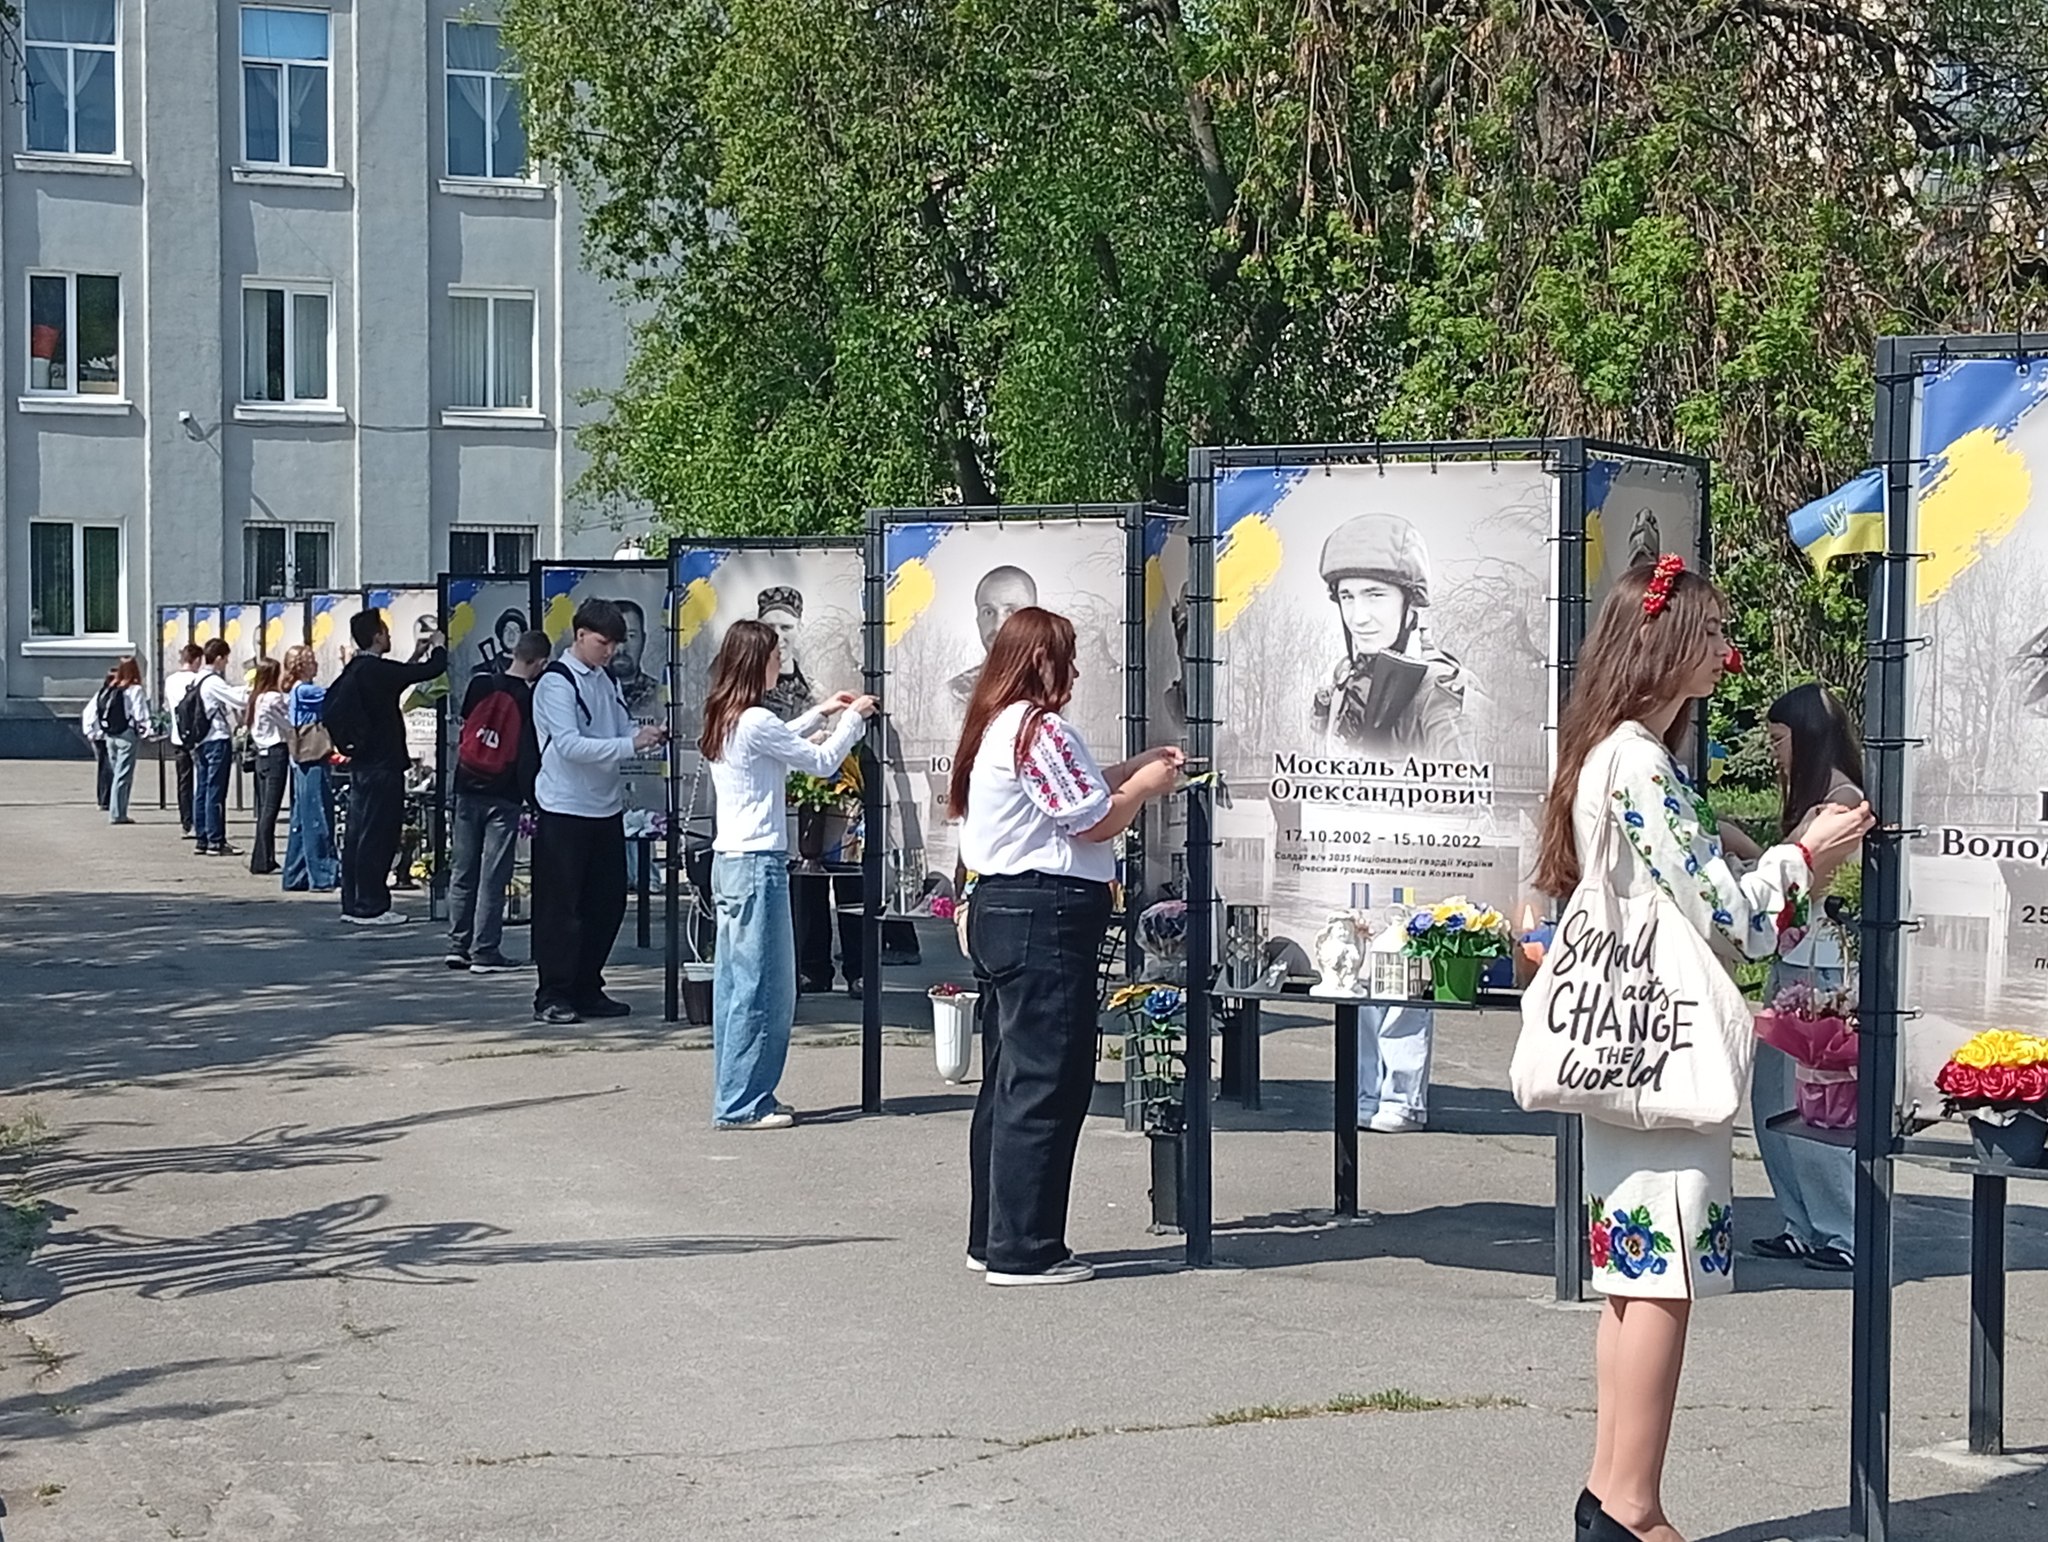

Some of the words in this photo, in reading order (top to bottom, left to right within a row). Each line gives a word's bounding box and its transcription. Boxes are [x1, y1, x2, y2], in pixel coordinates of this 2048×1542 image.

[1274, 753, 1394, 777] Москаль
[1403, 756, 1489, 783] Артем
[1271, 778, 1492, 808] Олександрович
[1284, 829, 1372, 845] 17.10.2002
[1393, 832, 1482, 848] 15.10.2022
[1274, 851, 1308, 862] Солдат
[1552, 909, 1660, 982] Small
[1621, 975, 1680, 1011] acts
[1547, 981, 1698, 1051] CHANGE
[1595, 1046, 1634, 1065] THE
